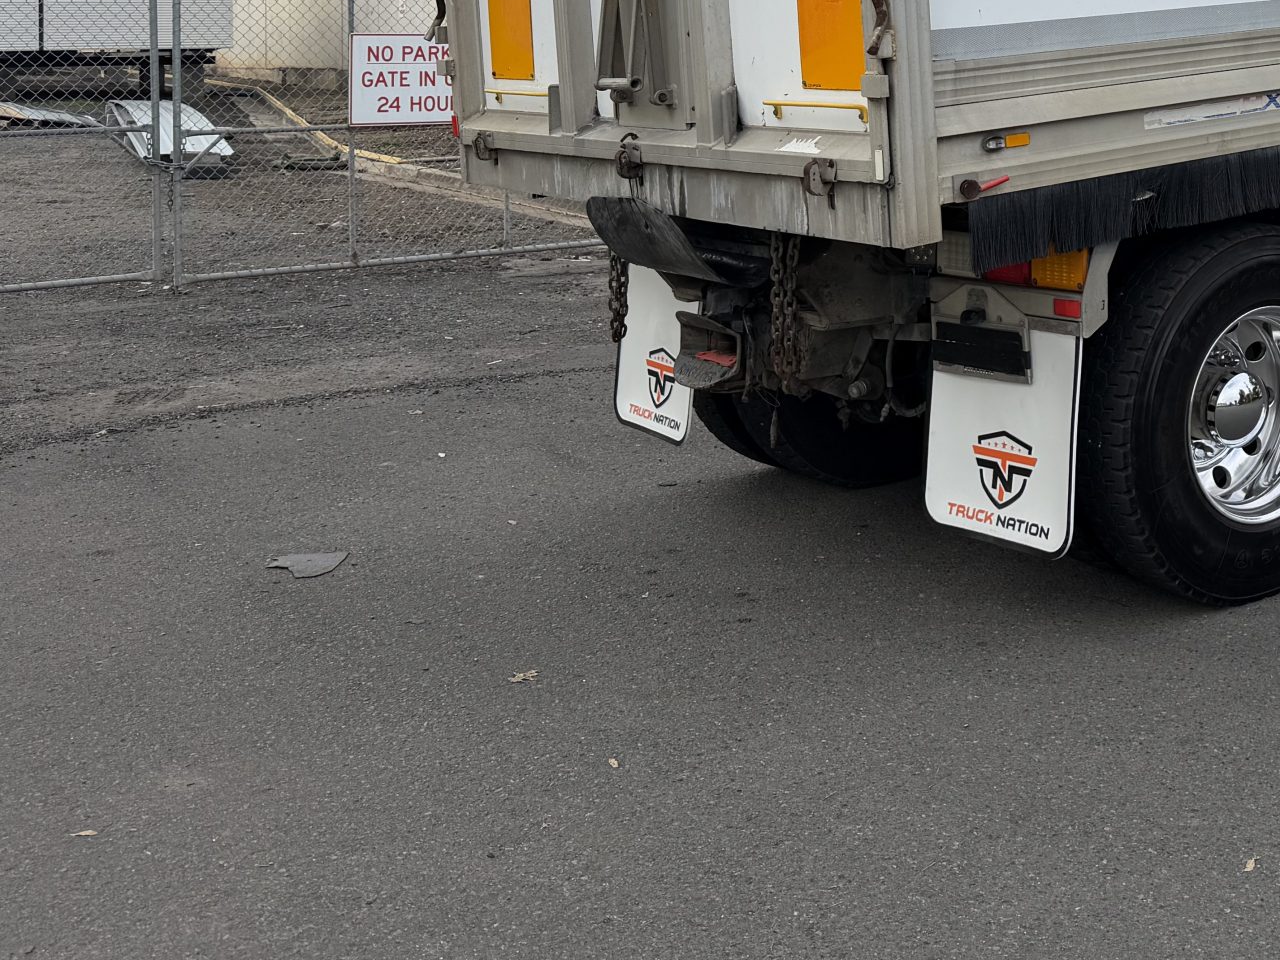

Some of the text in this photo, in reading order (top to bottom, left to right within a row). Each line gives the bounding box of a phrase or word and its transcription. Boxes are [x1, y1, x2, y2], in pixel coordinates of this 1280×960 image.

[367, 45, 394, 62] NO
[361, 70, 411, 88] GATE
[419, 70, 436, 87] IN
[377, 96, 401, 113] 24
[629, 403, 681, 432] TRUCK NATION
[948, 502, 1050, 540] TRUCK NATION
